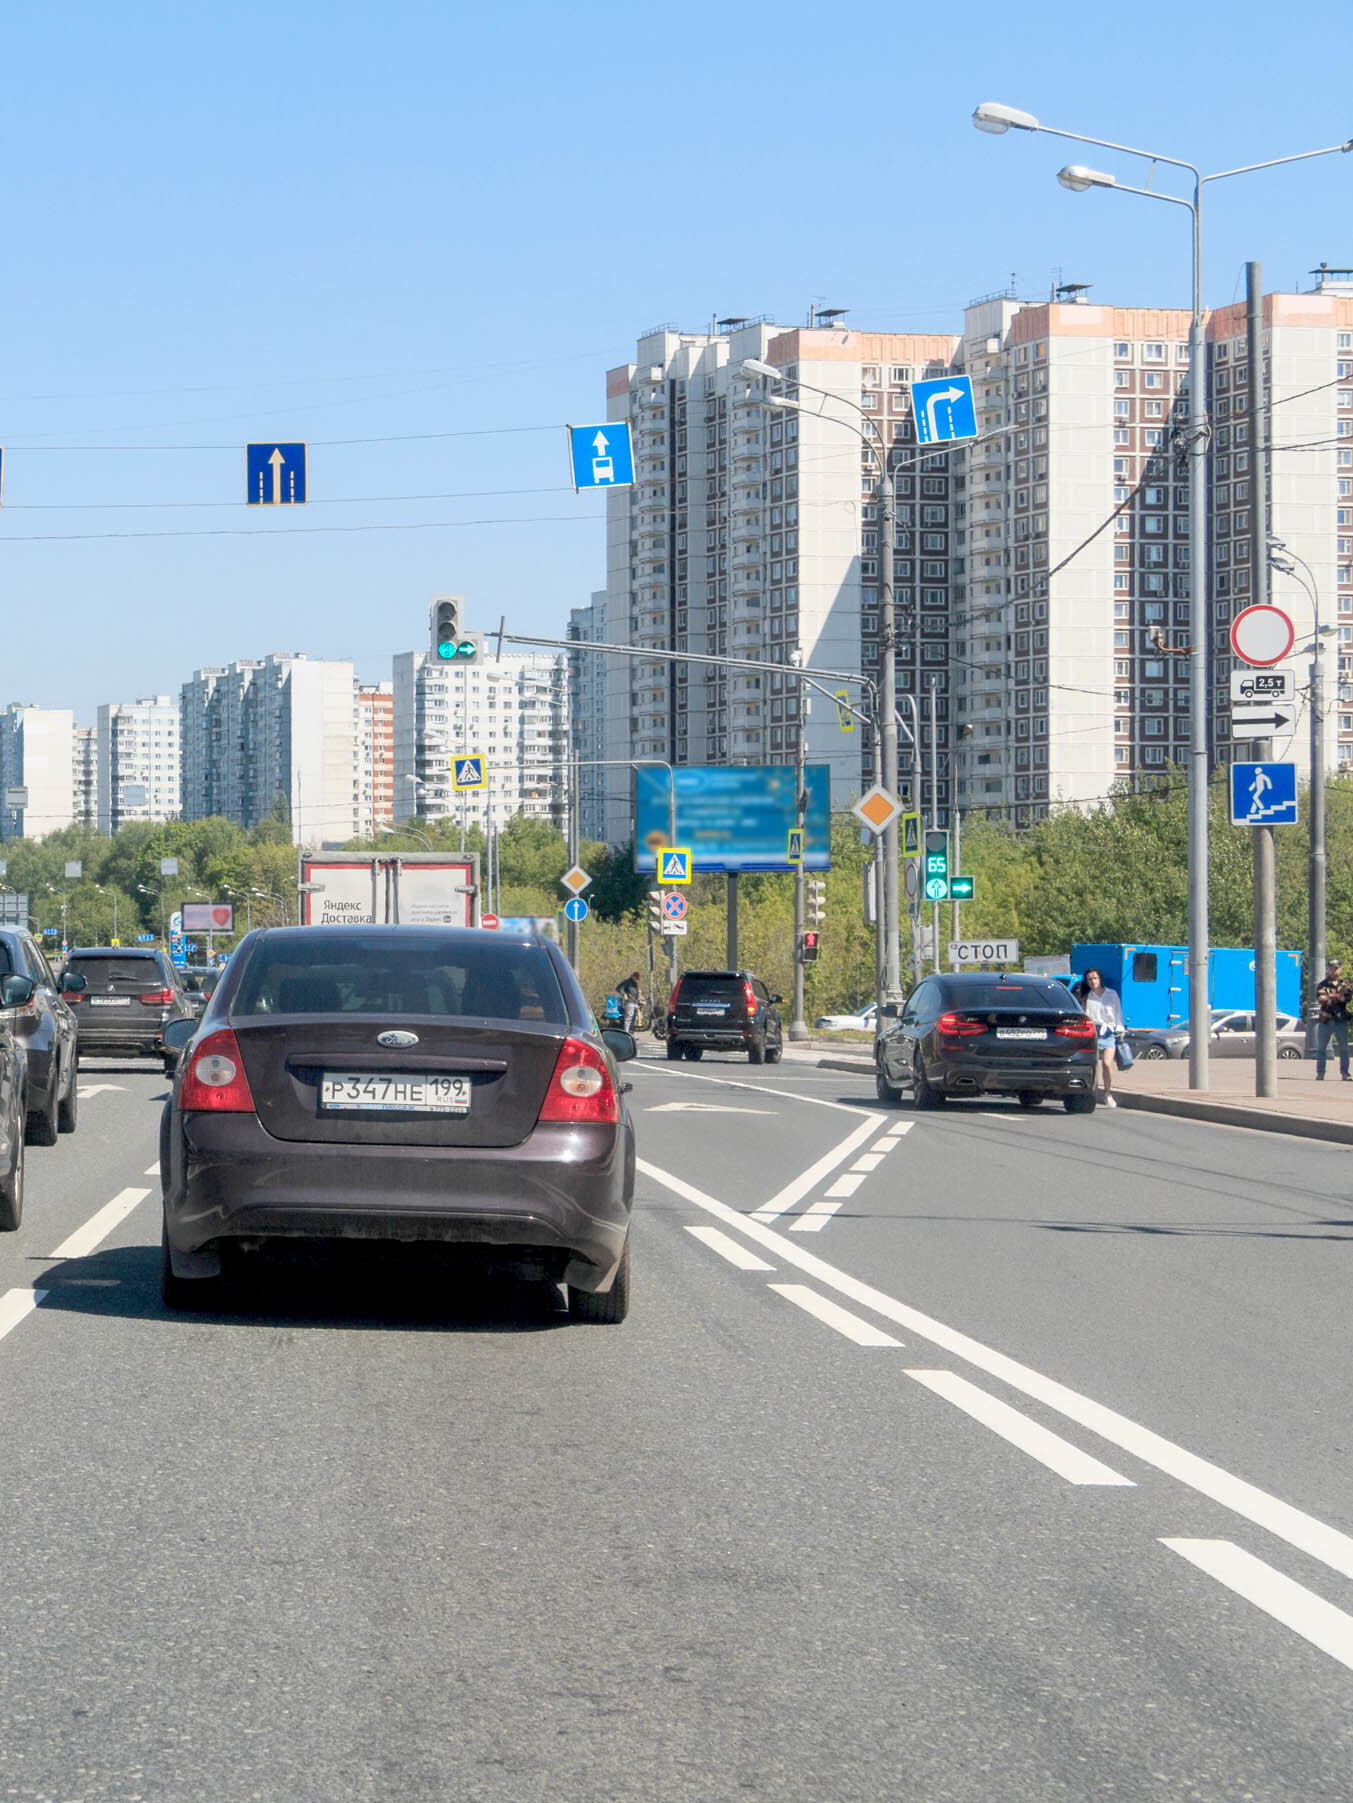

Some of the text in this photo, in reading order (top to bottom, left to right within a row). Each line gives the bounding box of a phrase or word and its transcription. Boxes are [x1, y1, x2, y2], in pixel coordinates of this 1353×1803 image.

[1259, 679, 1273, 688] 2,5
[928, 857, 946, 872] 65
[323, 900, 362, 911] Яндекс
[321, 913, 372, 925] Доставка
[958, 944, 1008, 960] СТОП
[430, 1078, 464, 1097] 199
